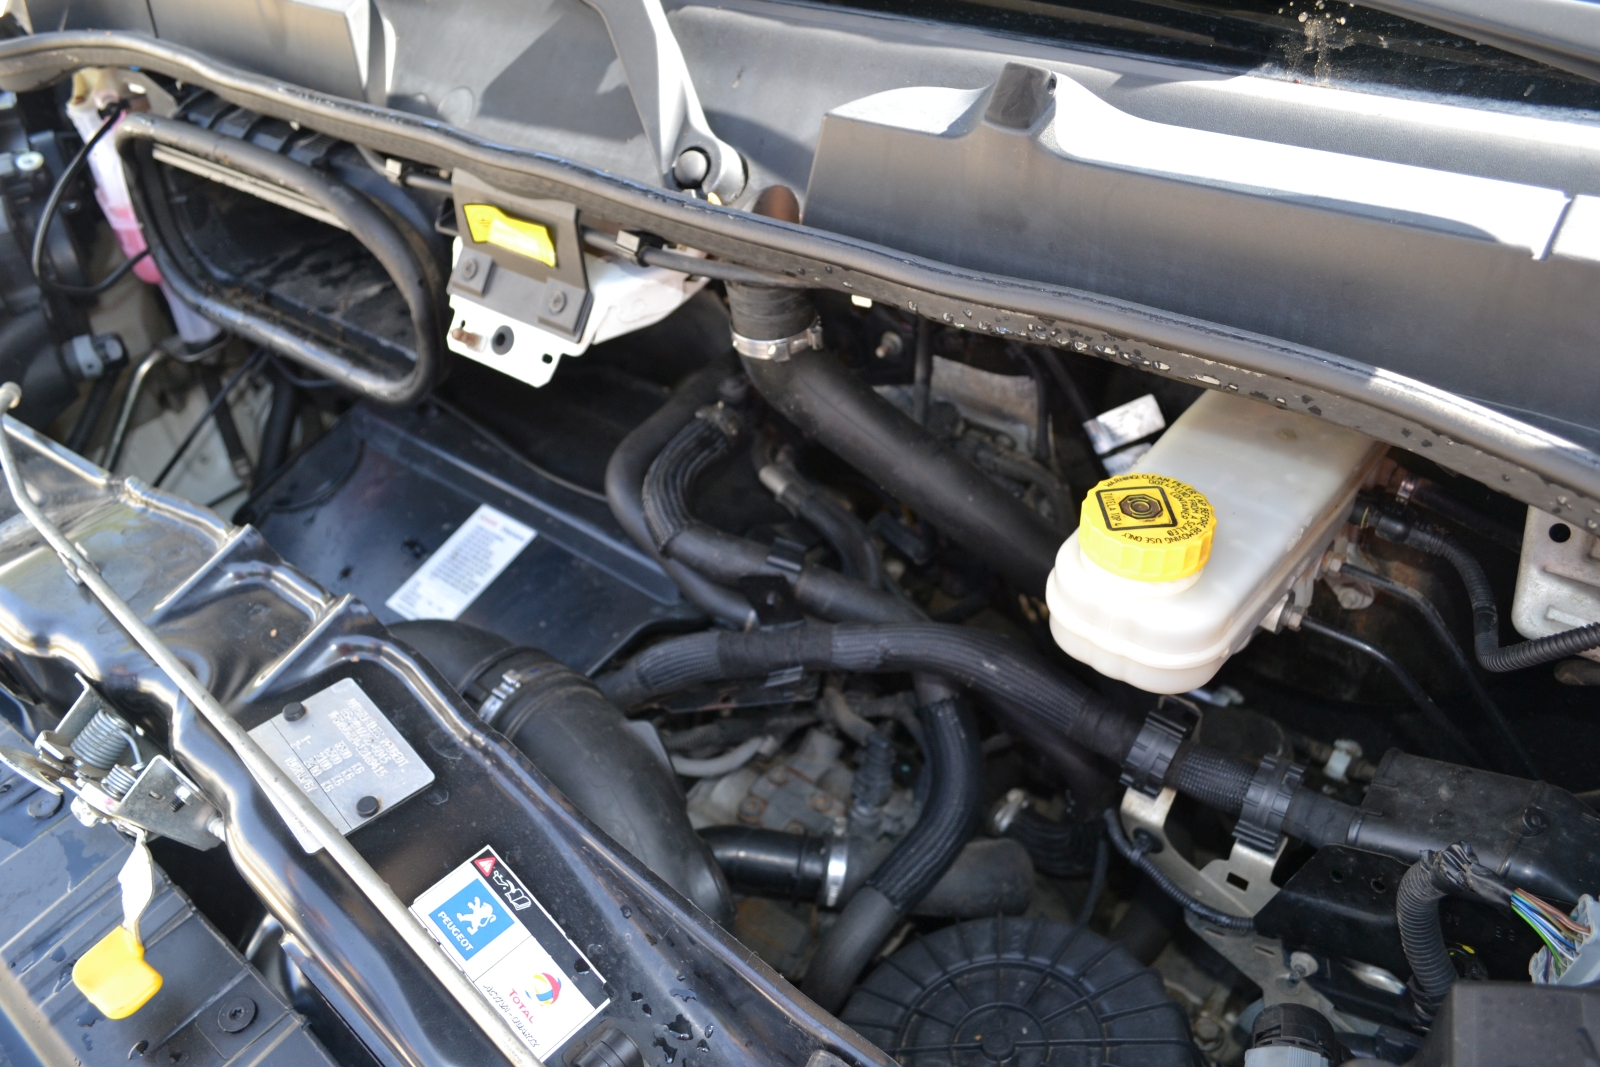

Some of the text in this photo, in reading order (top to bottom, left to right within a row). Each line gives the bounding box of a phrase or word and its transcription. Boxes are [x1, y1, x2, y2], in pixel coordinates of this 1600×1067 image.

[1142, 474, 1170, 482] CLEAN
[1172, 480, 1197, 494] FILLER
[1170, 491, 1190, 520] CONTAINER
[1188, 499, 1199, 514] FROM
[1194, 495, 1207, 507] CAP
[1198, 507, 1210, 528] BEFORE
[1121, 532, 1143, 542] ONLY
[1164, 526, 1202, 544] REMOVING
[1166, 520, 1196, 537] SEALED
[345, 698, 385, 738] AUTOMOBILES
[437, 910, 474, 952] PEUGEOT
[509, 988, 534, 1024] TOTAL
